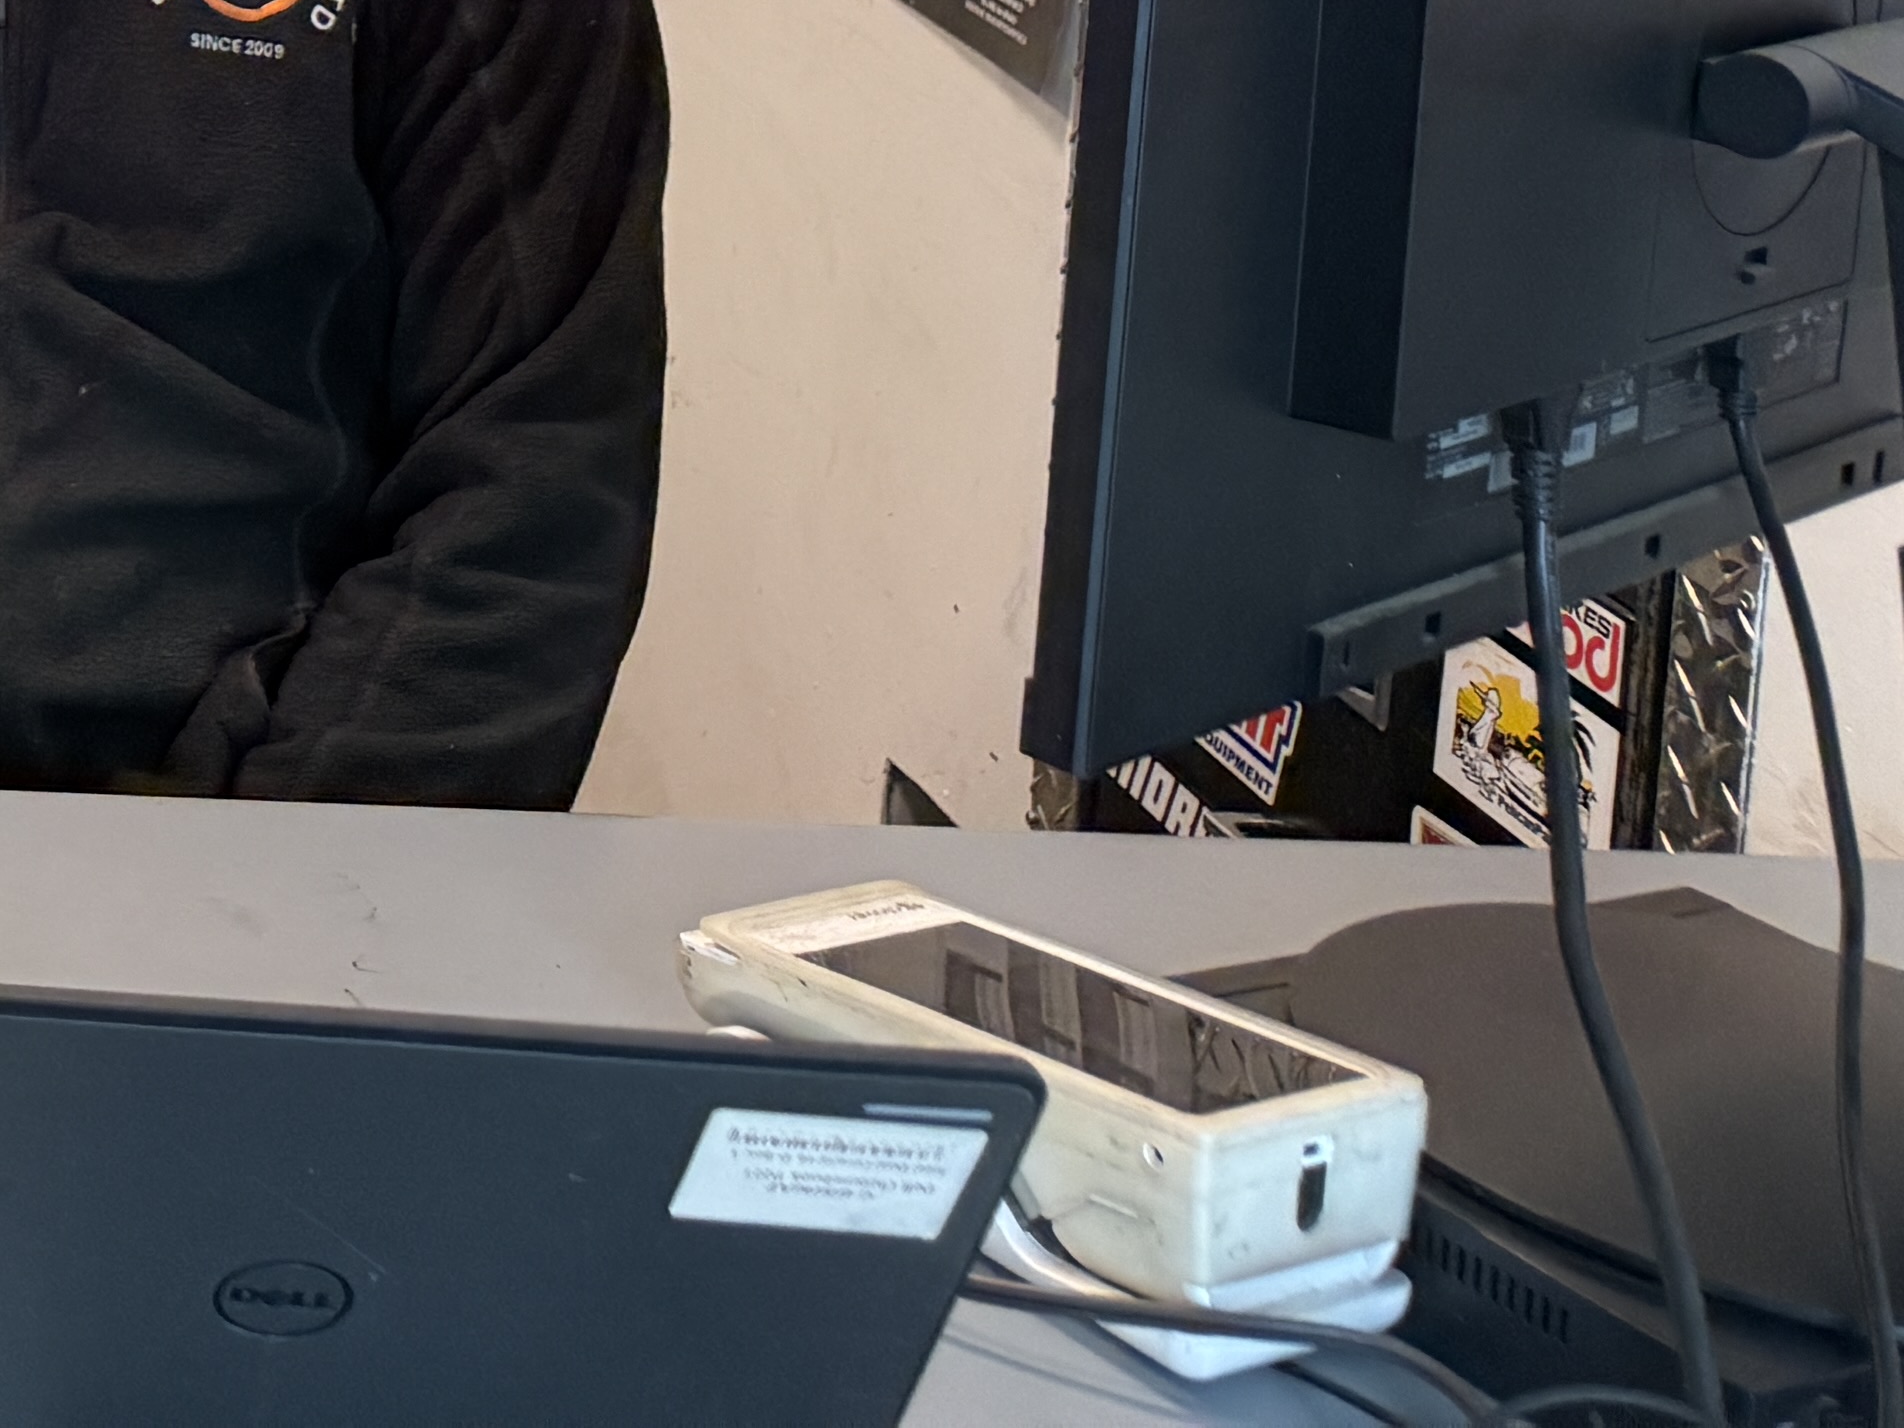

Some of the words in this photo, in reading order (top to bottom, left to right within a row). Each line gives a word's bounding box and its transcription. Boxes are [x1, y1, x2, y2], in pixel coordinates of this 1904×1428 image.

[190, 32, 242, 54] SINCE
[244, 39, 285, 60] 2009
[230, 1287, 332, 1309] DELL
